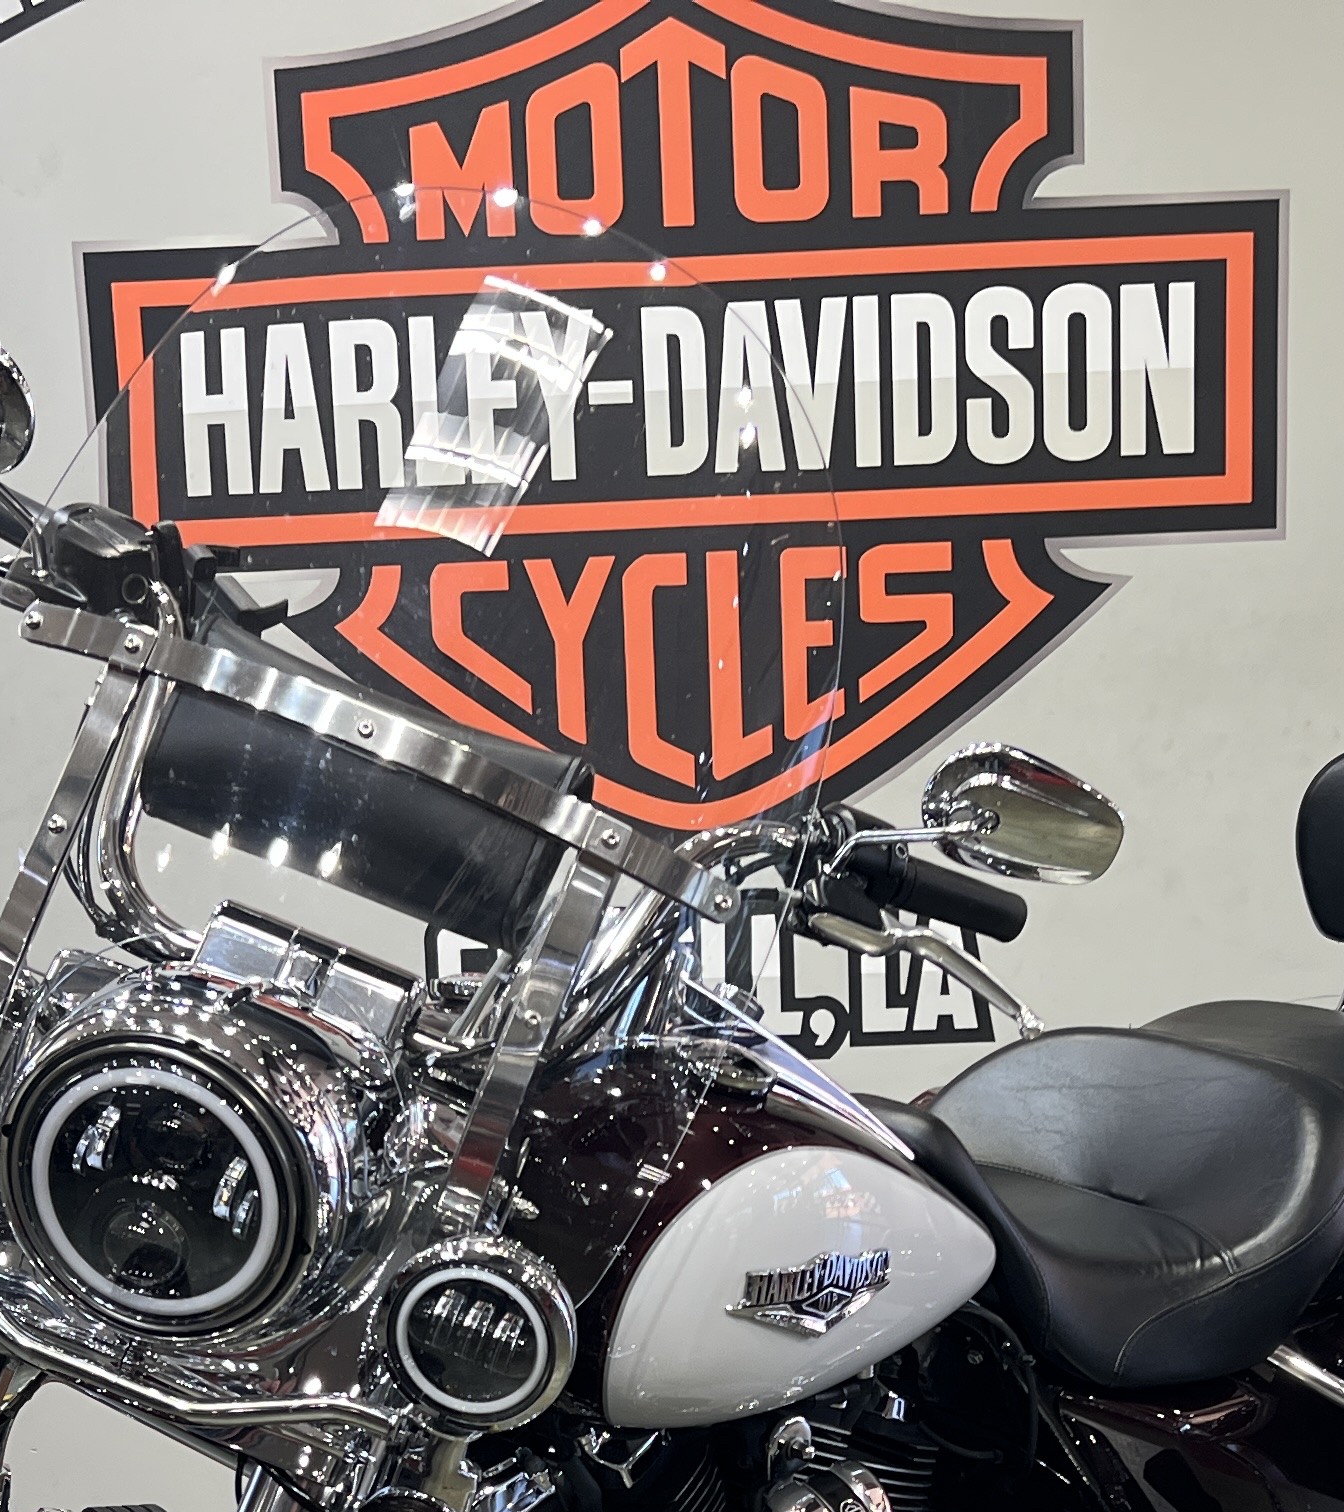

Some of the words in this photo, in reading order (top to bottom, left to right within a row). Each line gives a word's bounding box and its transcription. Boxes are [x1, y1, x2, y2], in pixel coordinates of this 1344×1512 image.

[409, 16, 949, 242] MOTOR
[179, 282, 1196, 499] HARLEY-DAVIDSON
[430, 541, 955, 788] CYCLES
[860, 910, 980, 1034] LA
